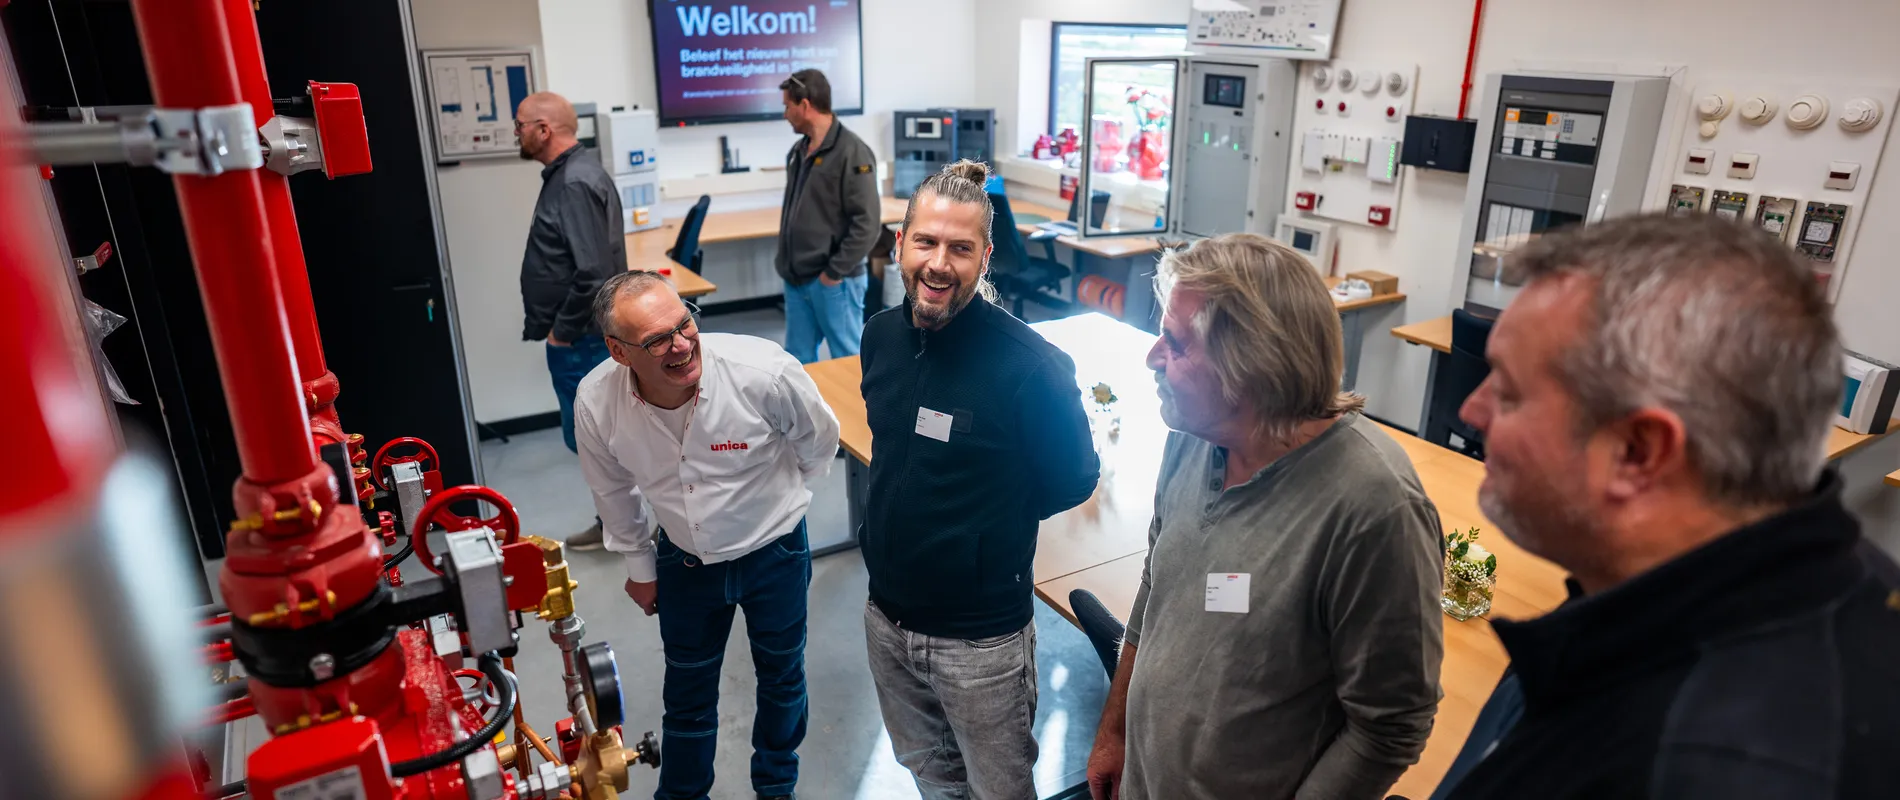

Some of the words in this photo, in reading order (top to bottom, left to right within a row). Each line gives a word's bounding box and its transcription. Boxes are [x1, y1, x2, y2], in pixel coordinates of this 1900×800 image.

[676, 5, 816, 36] Welkom!
[680, 48, 720, 62] Beleef
[723, 47, 744, 61] het
[746, 47, 789, 60] nieuwe
[681, 62, 775, 78] brandveiligheid
[777, 61, 789, 74] in
[711, 440, 748, 451] unica
